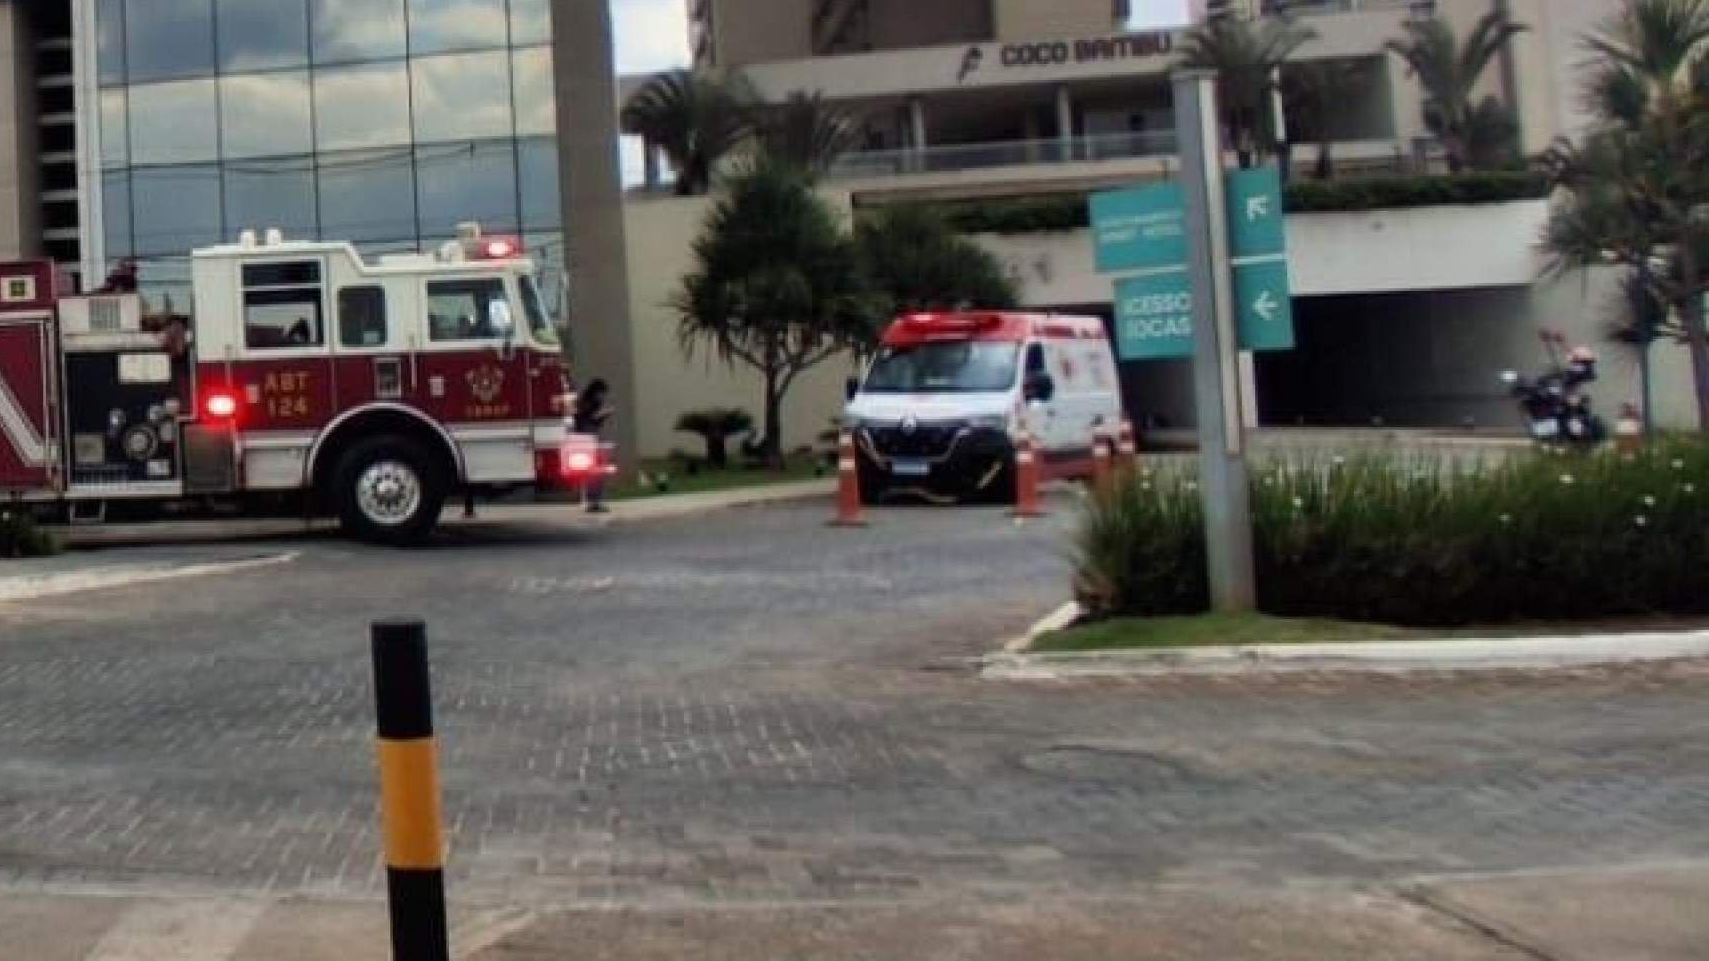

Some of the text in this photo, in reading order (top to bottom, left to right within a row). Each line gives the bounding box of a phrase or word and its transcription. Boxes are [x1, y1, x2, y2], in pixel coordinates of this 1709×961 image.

[1001, 41, 1069, 68] COCO
[264, 371, 310, 391] ABT
[266, 396, 310, 417] 124
